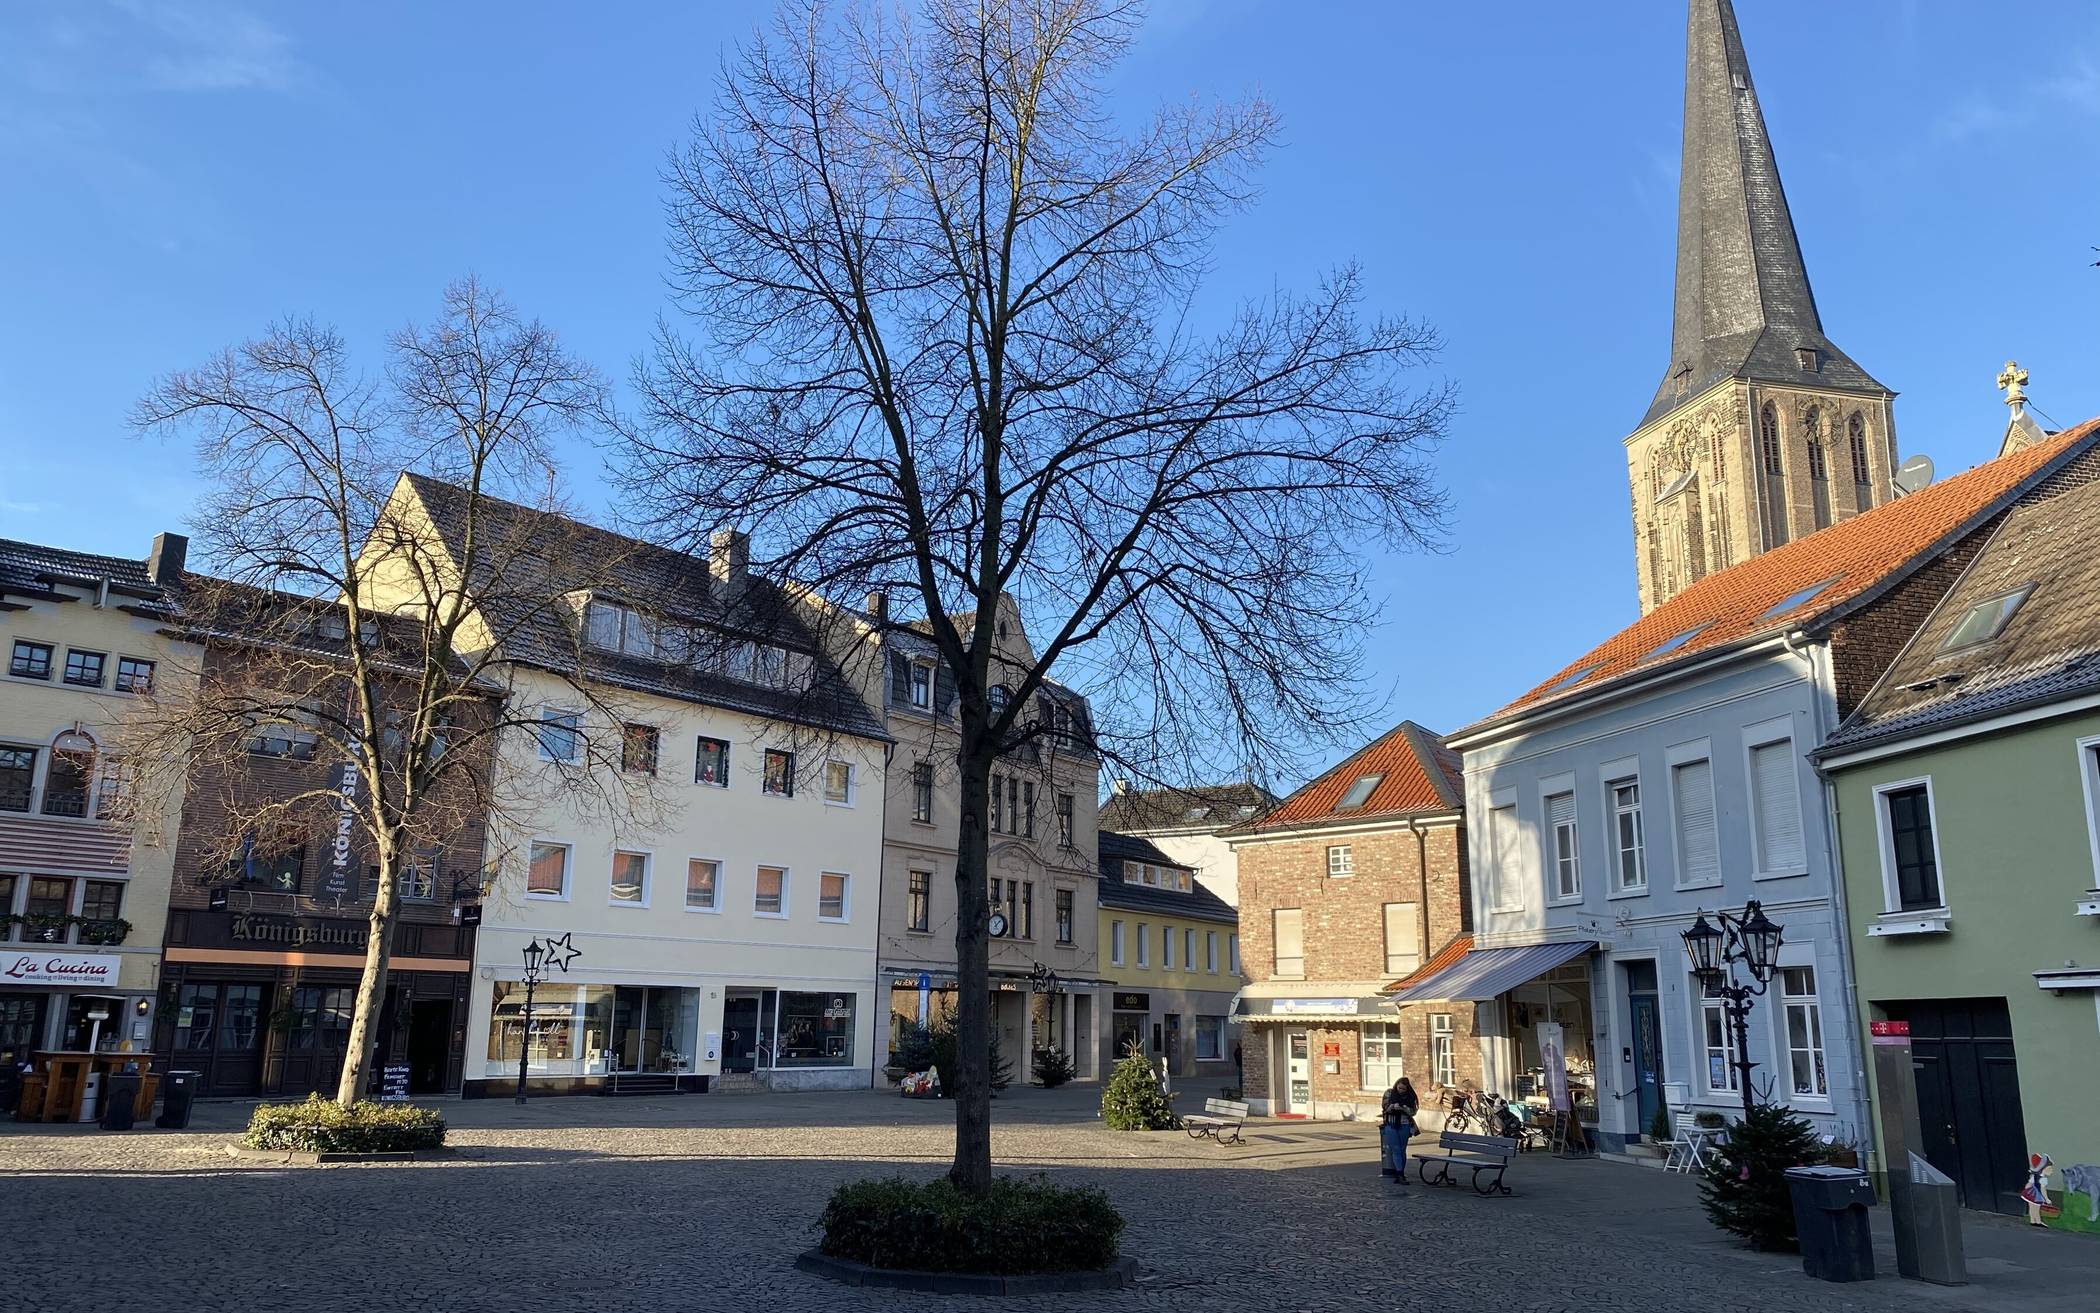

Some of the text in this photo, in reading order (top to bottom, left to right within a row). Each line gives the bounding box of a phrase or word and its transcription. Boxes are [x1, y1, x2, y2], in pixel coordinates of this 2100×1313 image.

[326, 885, 348, 893] Theater
[5, 957, 109, 978] La Cucina
[58, 975, 78, 983] living
[83, 975, 105, 983] dining
